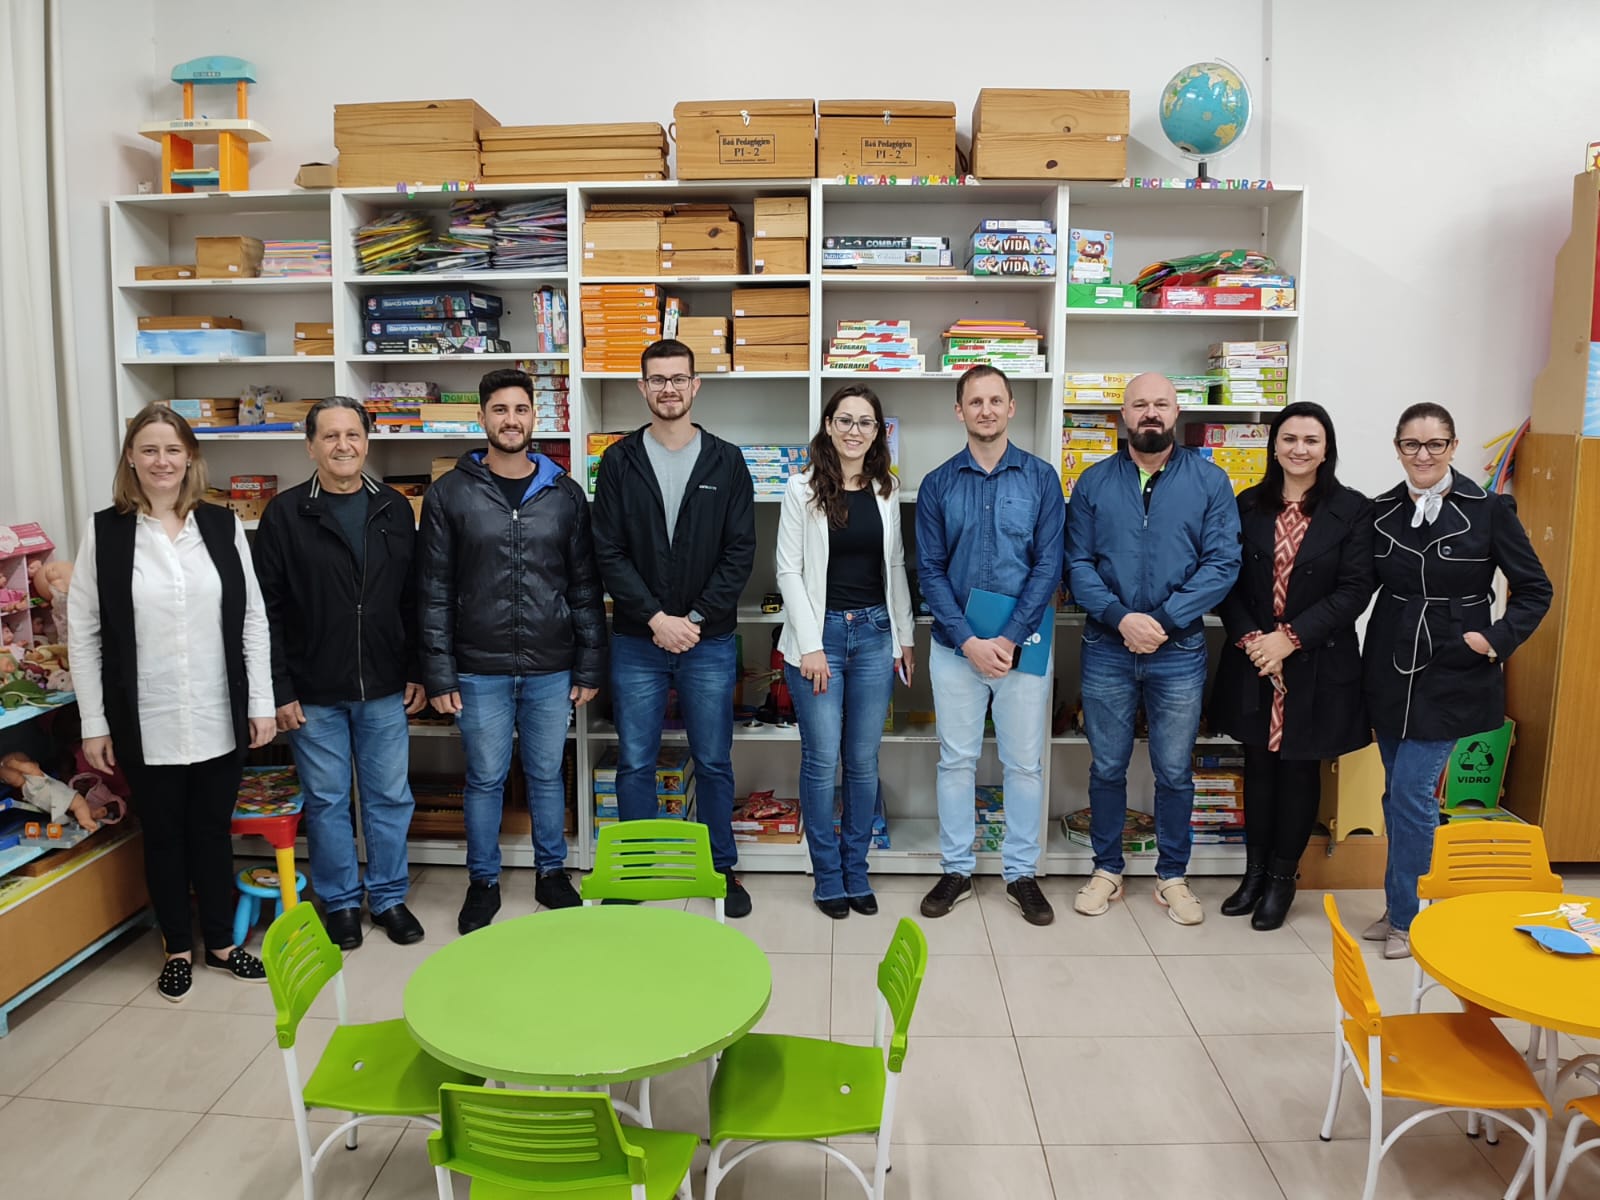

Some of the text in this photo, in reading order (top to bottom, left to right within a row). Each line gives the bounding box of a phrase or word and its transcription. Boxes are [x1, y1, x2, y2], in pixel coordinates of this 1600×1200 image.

[734, 148, 744, 157] PI
[754, 148, 760, 157] 2
[876, 150, 886, 159] PI
[895, 150, 901, 159] 2
[911, 174, 976, 186] HUMANAS
[1185, 177, 1202, 190] DA
[1210, 178, 1274, 191] NATUREZA
[866, 239, 908, 248] COMBATE
[1003, 239, 1030, 251] VIDA
[1002, 260, 1029, 272] VIDA
[1457, 776, 1491, 784] VIDRO
